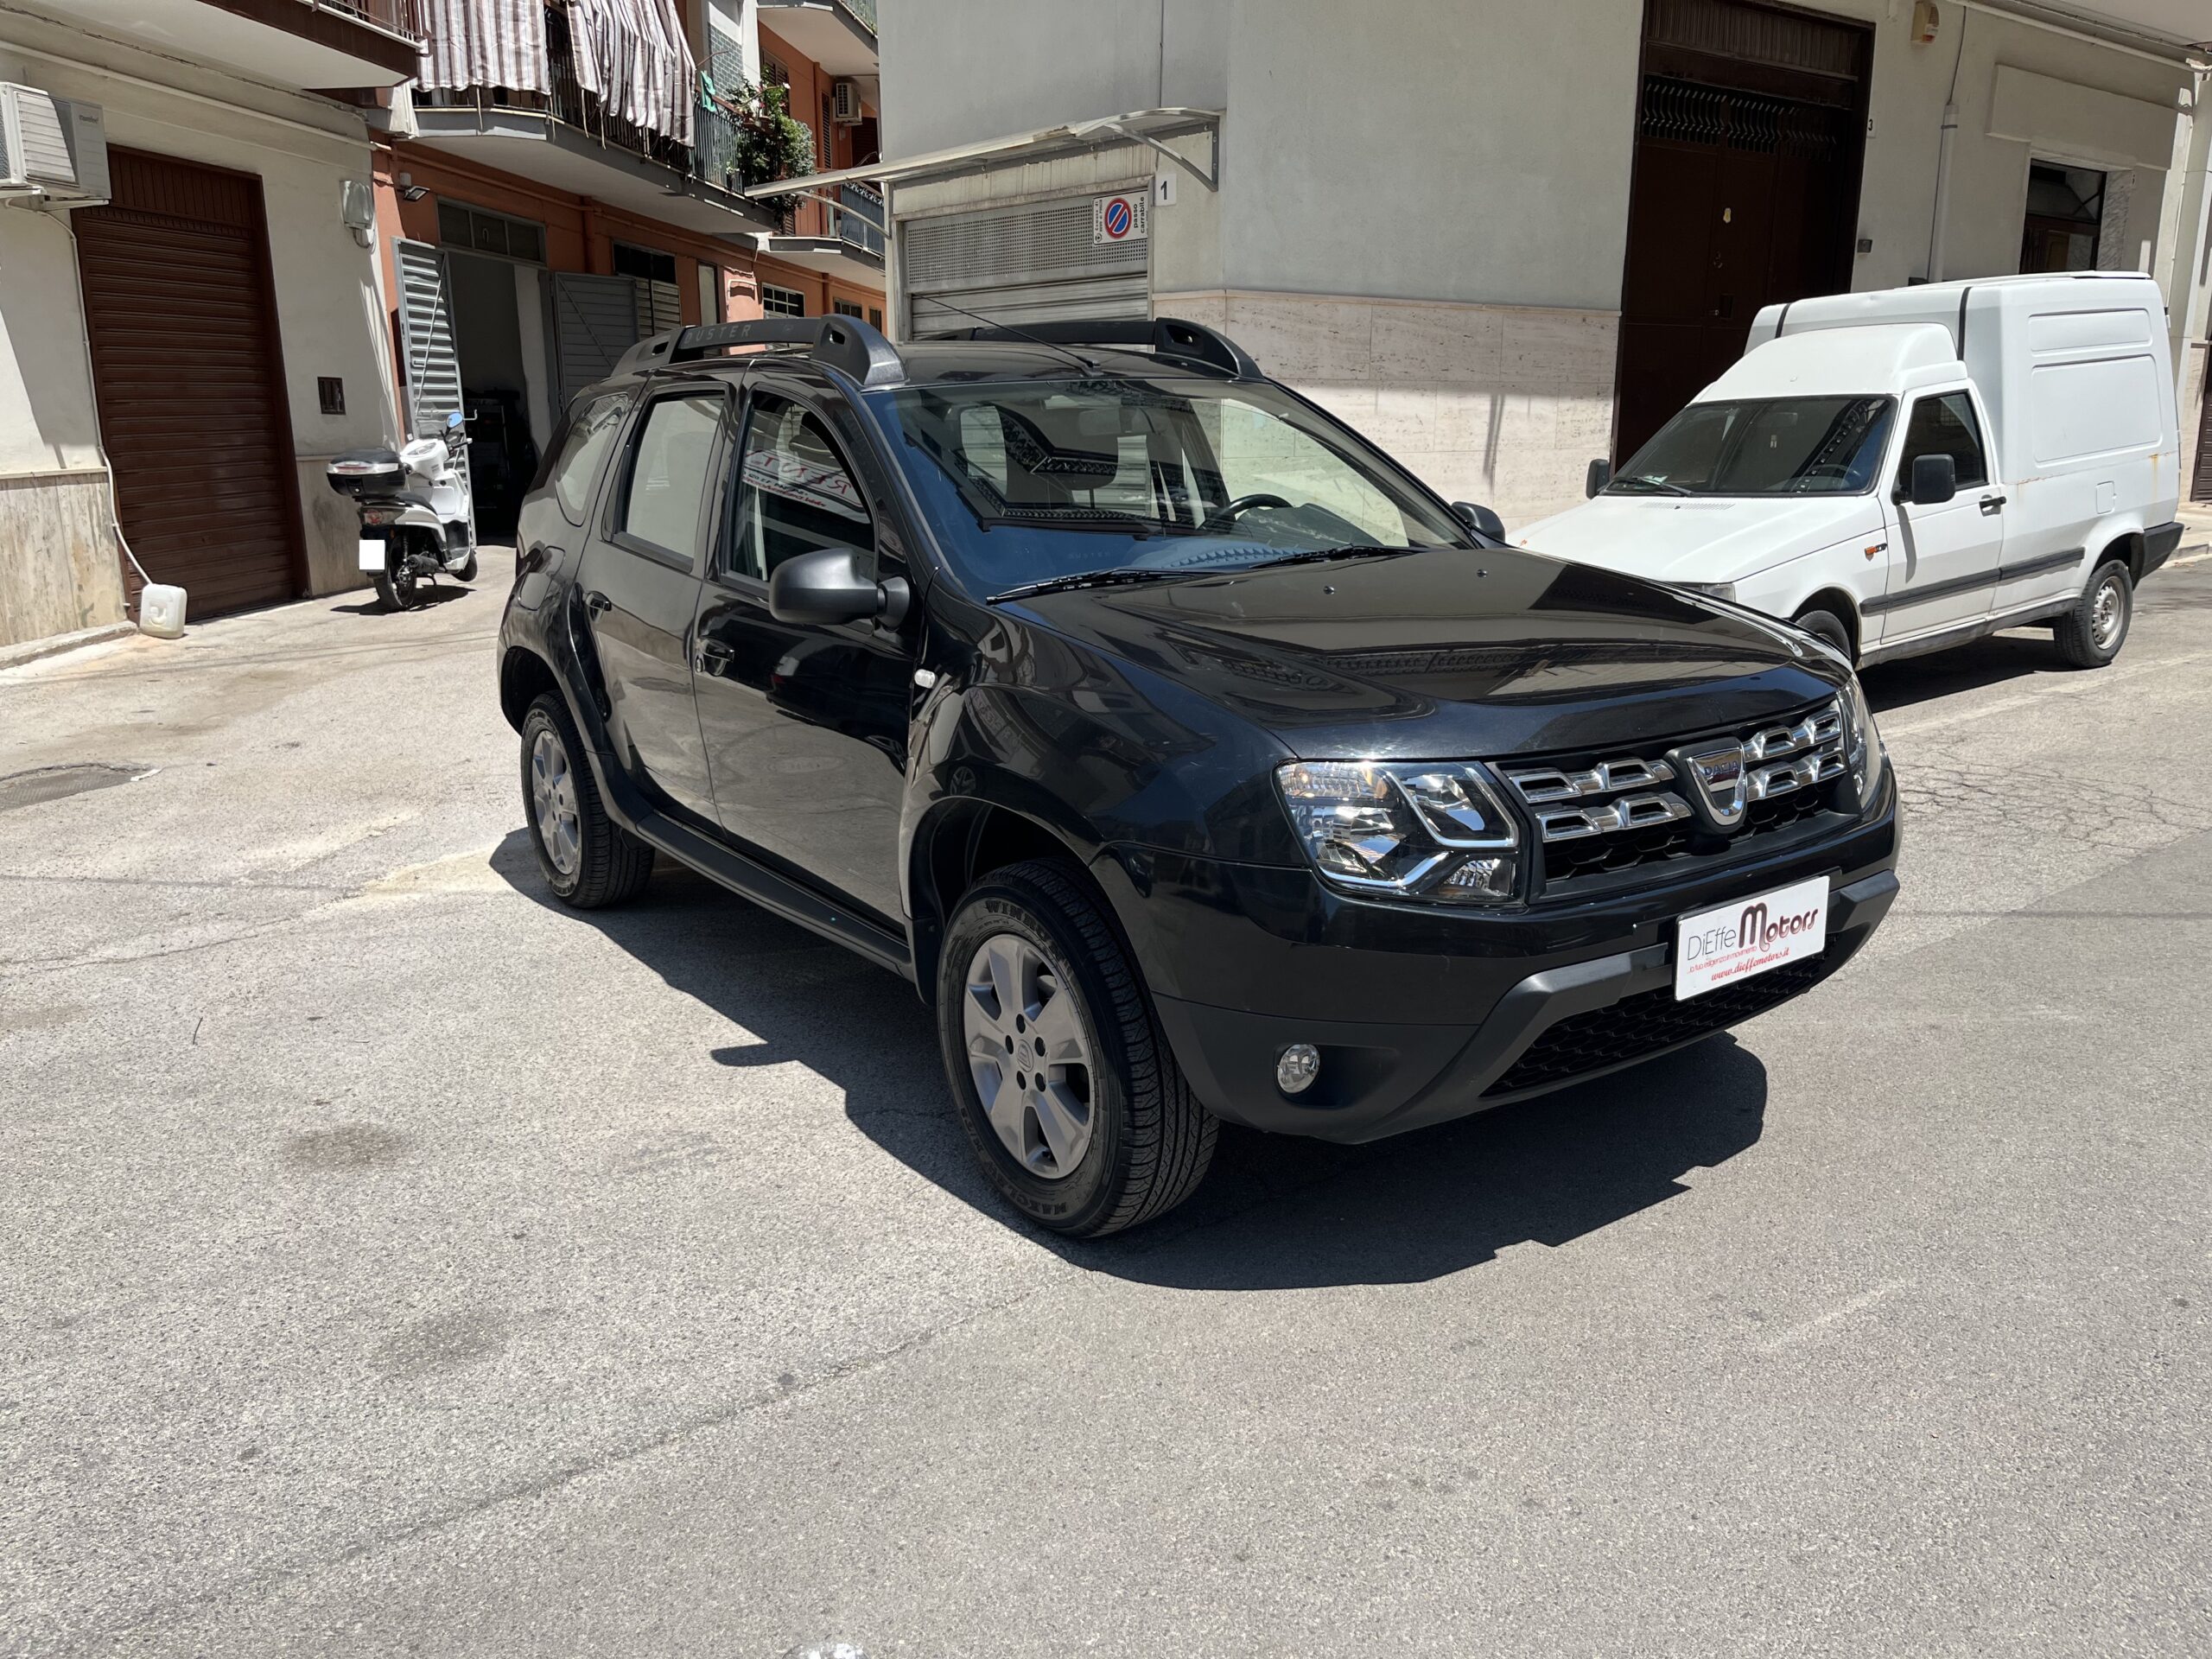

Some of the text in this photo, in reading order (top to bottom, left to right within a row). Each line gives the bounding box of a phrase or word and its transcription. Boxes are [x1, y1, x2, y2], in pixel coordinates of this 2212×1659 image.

[1867, 118, 1873, 131] 3
[1160, 181, 1168, 200] 1
[684, 324, 752, 344] DUSTER
[1704, 760, 1740, 776] DACIA
[1688, 902, 1819, 961] DiEffe Motors
[1711, 947, 1790, 982] www.dieffemotors.it
